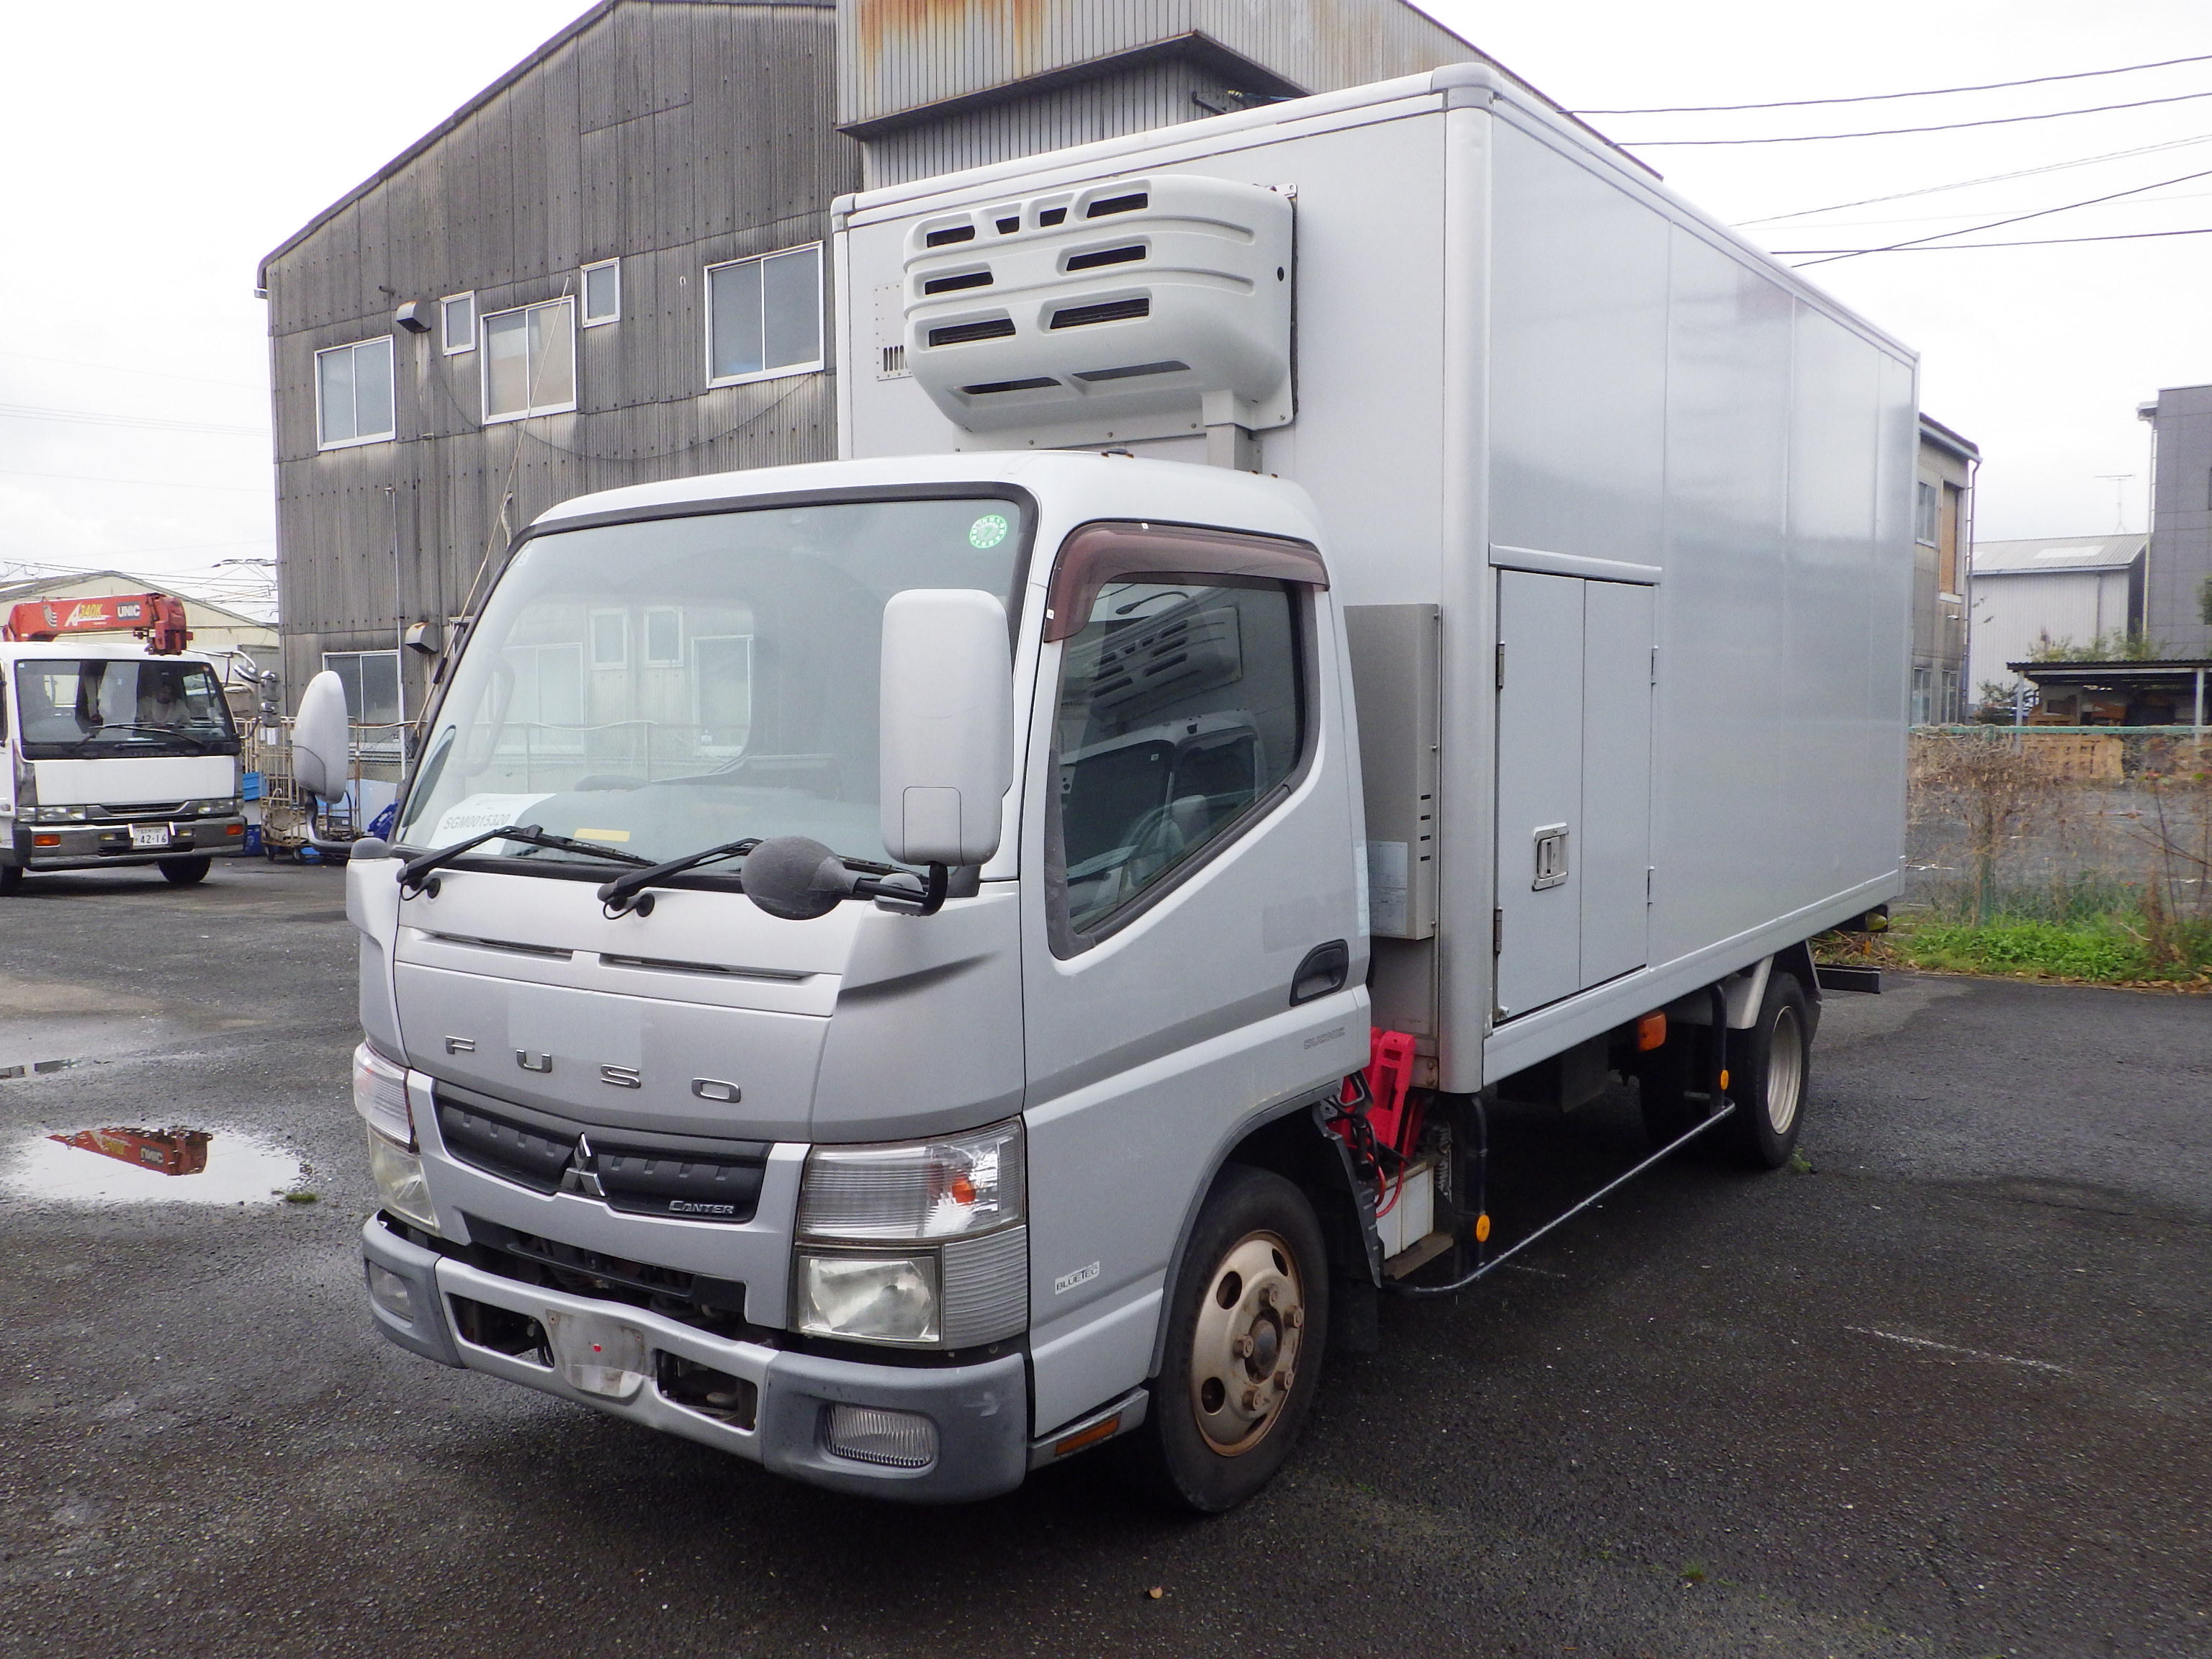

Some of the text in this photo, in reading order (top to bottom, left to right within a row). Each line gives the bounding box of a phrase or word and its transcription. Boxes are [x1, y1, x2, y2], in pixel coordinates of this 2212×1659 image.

[117, 605, 140, 617] UNIC
[444, 814, 511, 830] SGM0015320
[445, 1035, 741, 1103] FUSO
